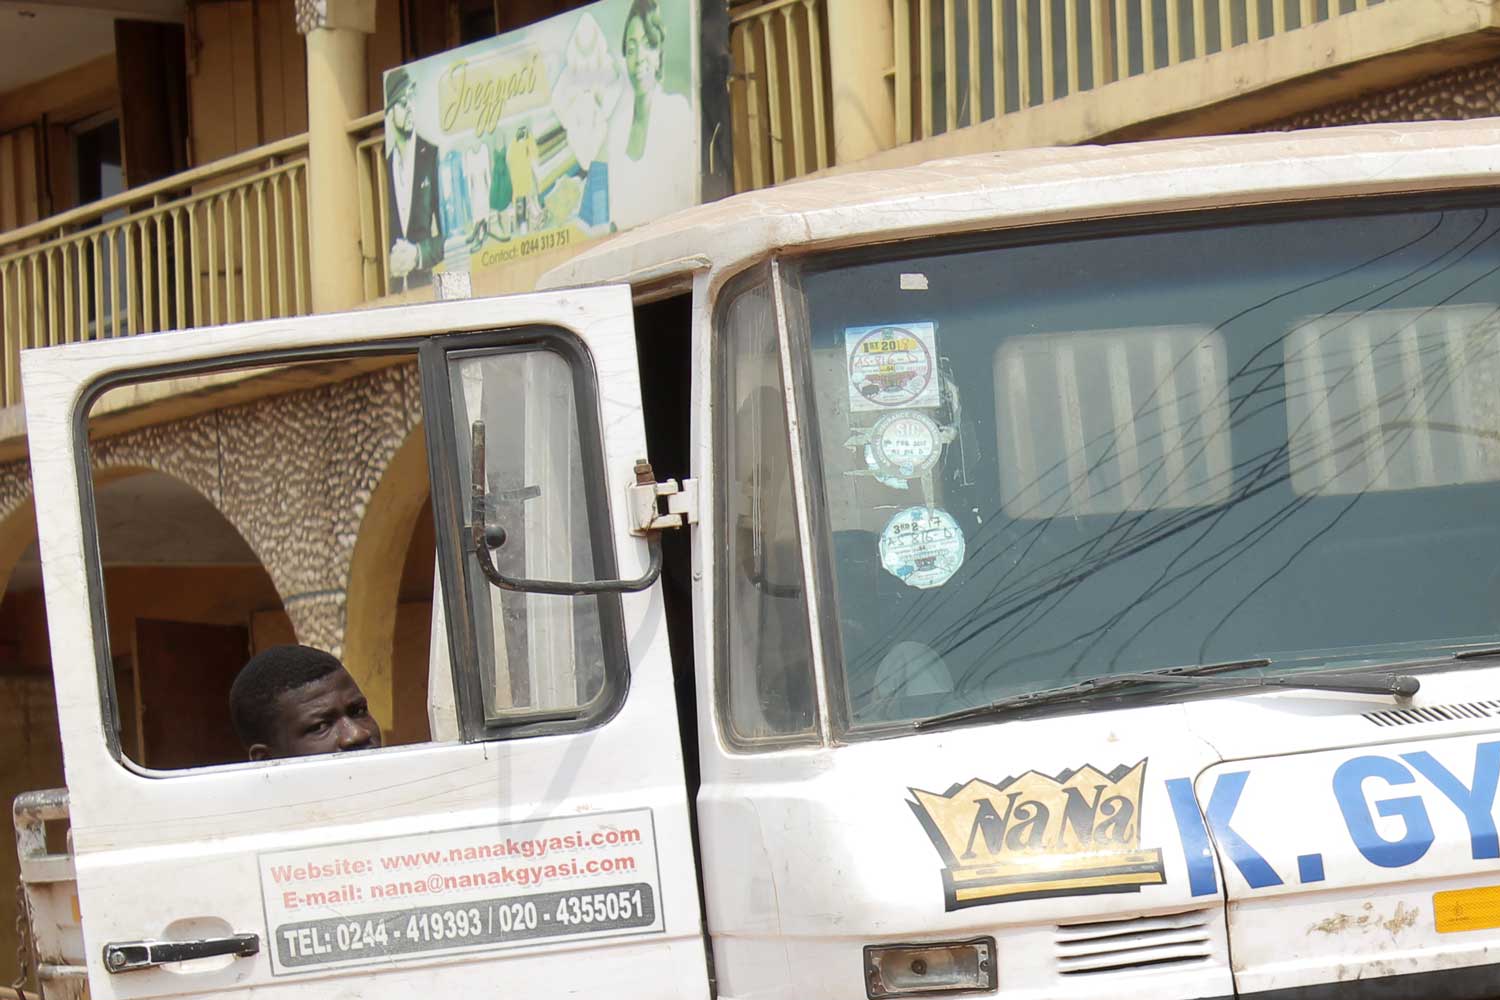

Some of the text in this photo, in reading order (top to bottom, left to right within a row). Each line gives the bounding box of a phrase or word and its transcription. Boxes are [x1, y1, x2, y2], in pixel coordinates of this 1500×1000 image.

[481, 229, 569, 267] Contact: 0244 313 751
[270, 828, 641, 884] Website: www.nanakgyasi.com
[1165, 770, 1326, 898] K.
[283, 856, 636, 909] E-mail: nana@nanakgyasi.com
[284, 927, 332, 958] TEL:
[336, 920, 389, 951] 0244
[406, 908, 482, 942] 419393
[500, 901, 537, 932] 020
[556, 890, 643, 926] 4355051
